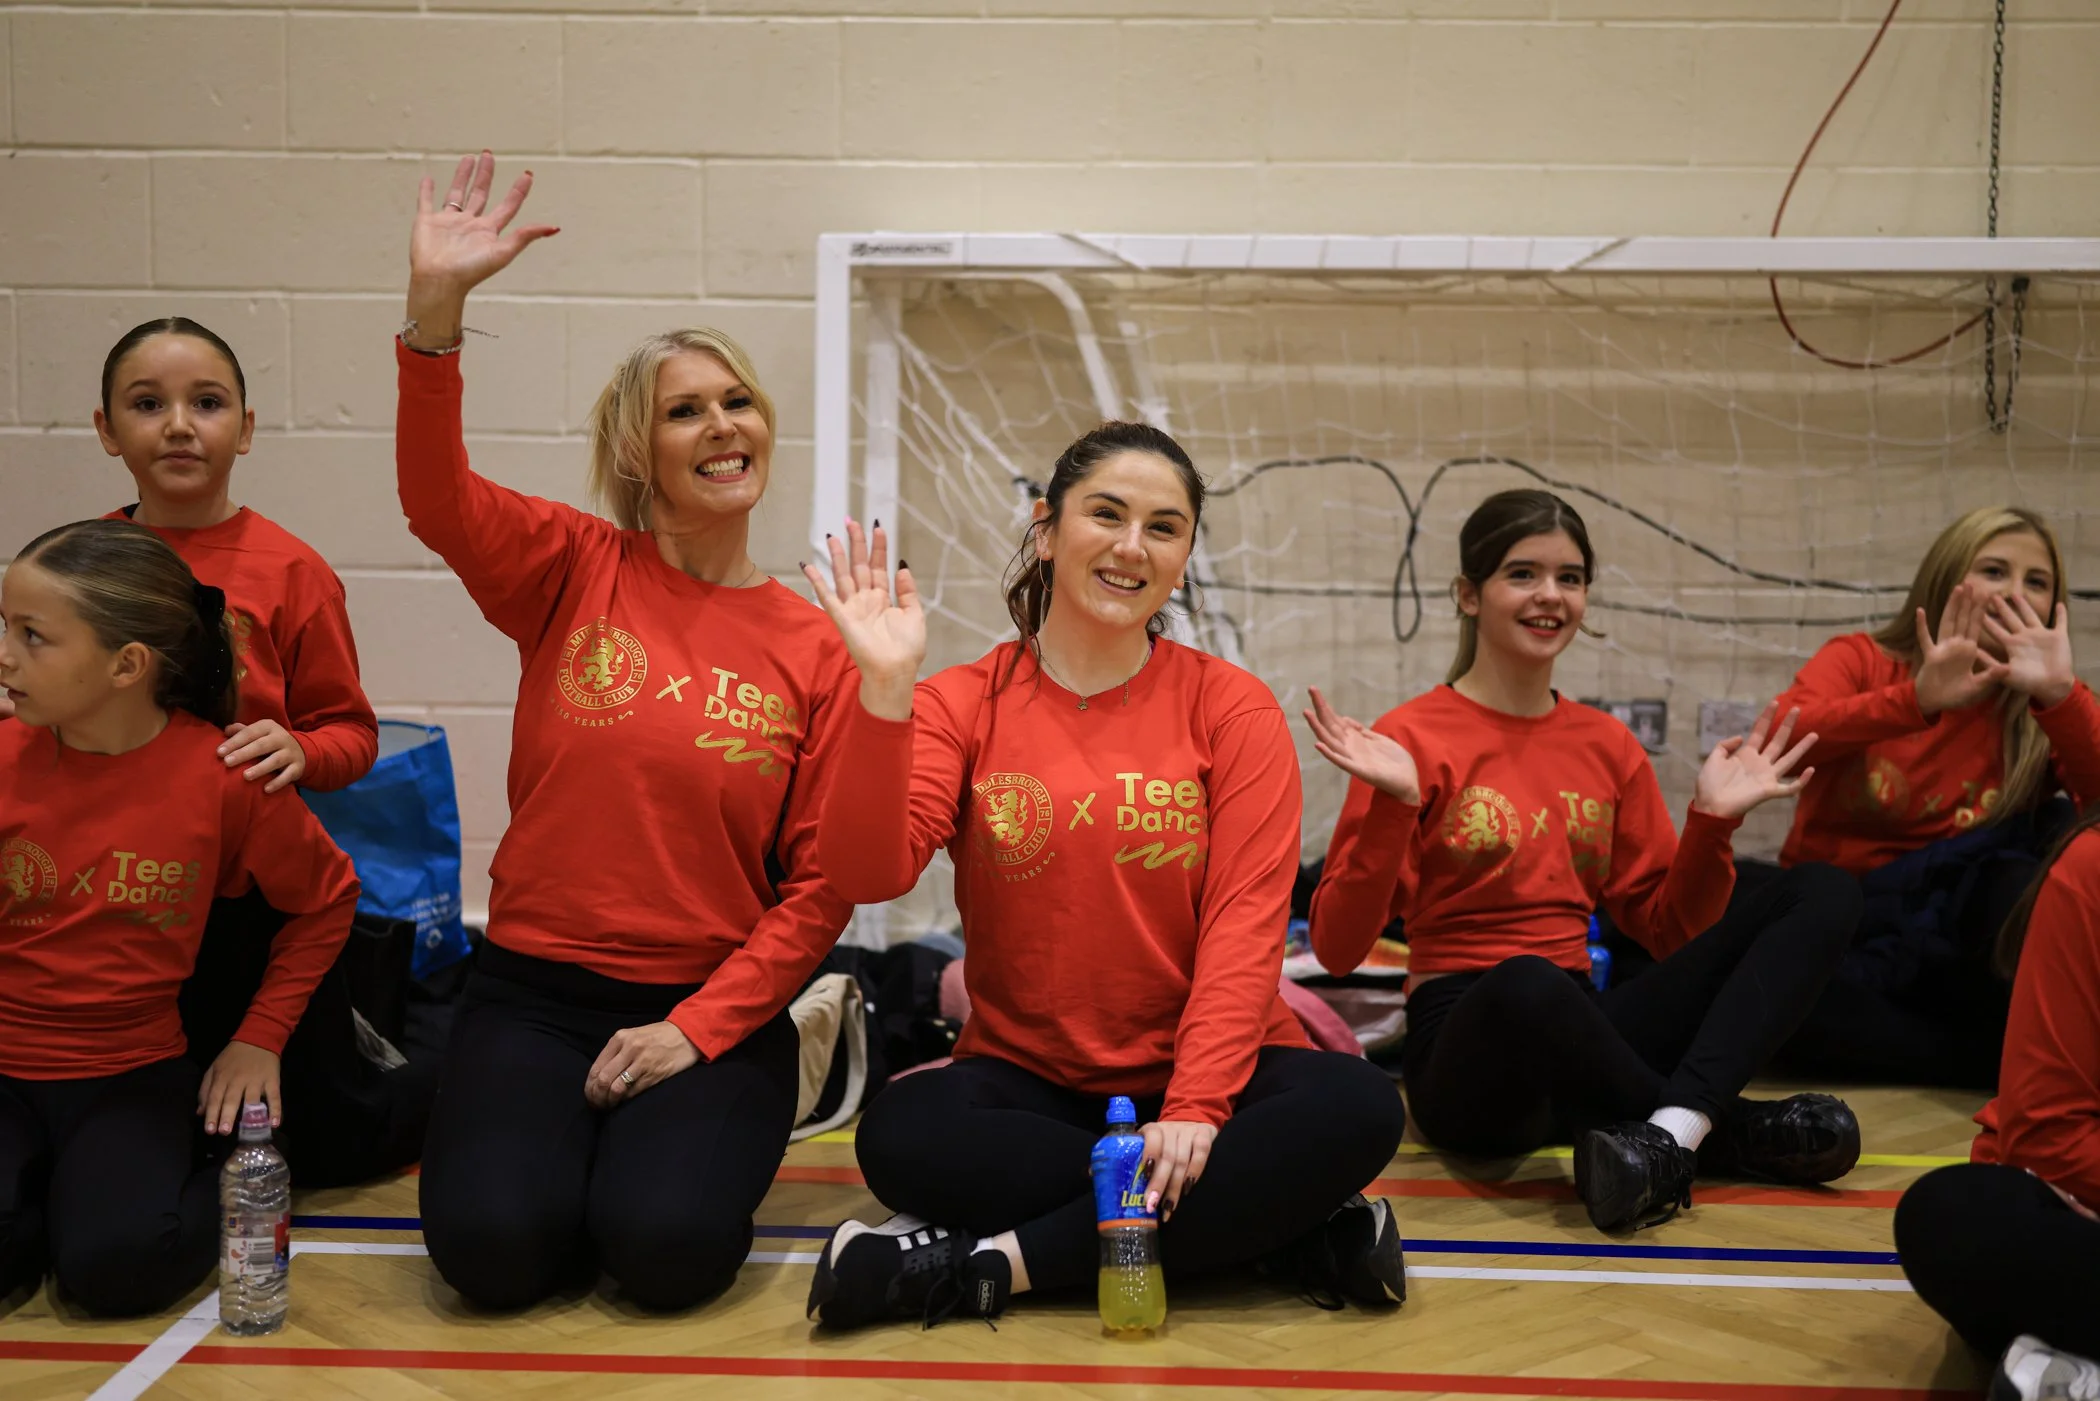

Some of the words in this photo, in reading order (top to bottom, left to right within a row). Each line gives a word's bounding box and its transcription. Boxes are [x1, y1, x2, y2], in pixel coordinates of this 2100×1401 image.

[560, 668, 601, 707] FOOTBALL
[603, 685, 635, 705] CLUB
[574, 716, 614, 728] YEARS
[974, 775, 1048, 805] DDLESBROUGH
[1115, 772, 1202, 809] Tee
[1040, 810, 1050, 818] 76
[1116, 805, 1203, 835] Danc
[1023, 826, 1047, 856] CLUB
[1005, 865, 1042, 882] YEARS
